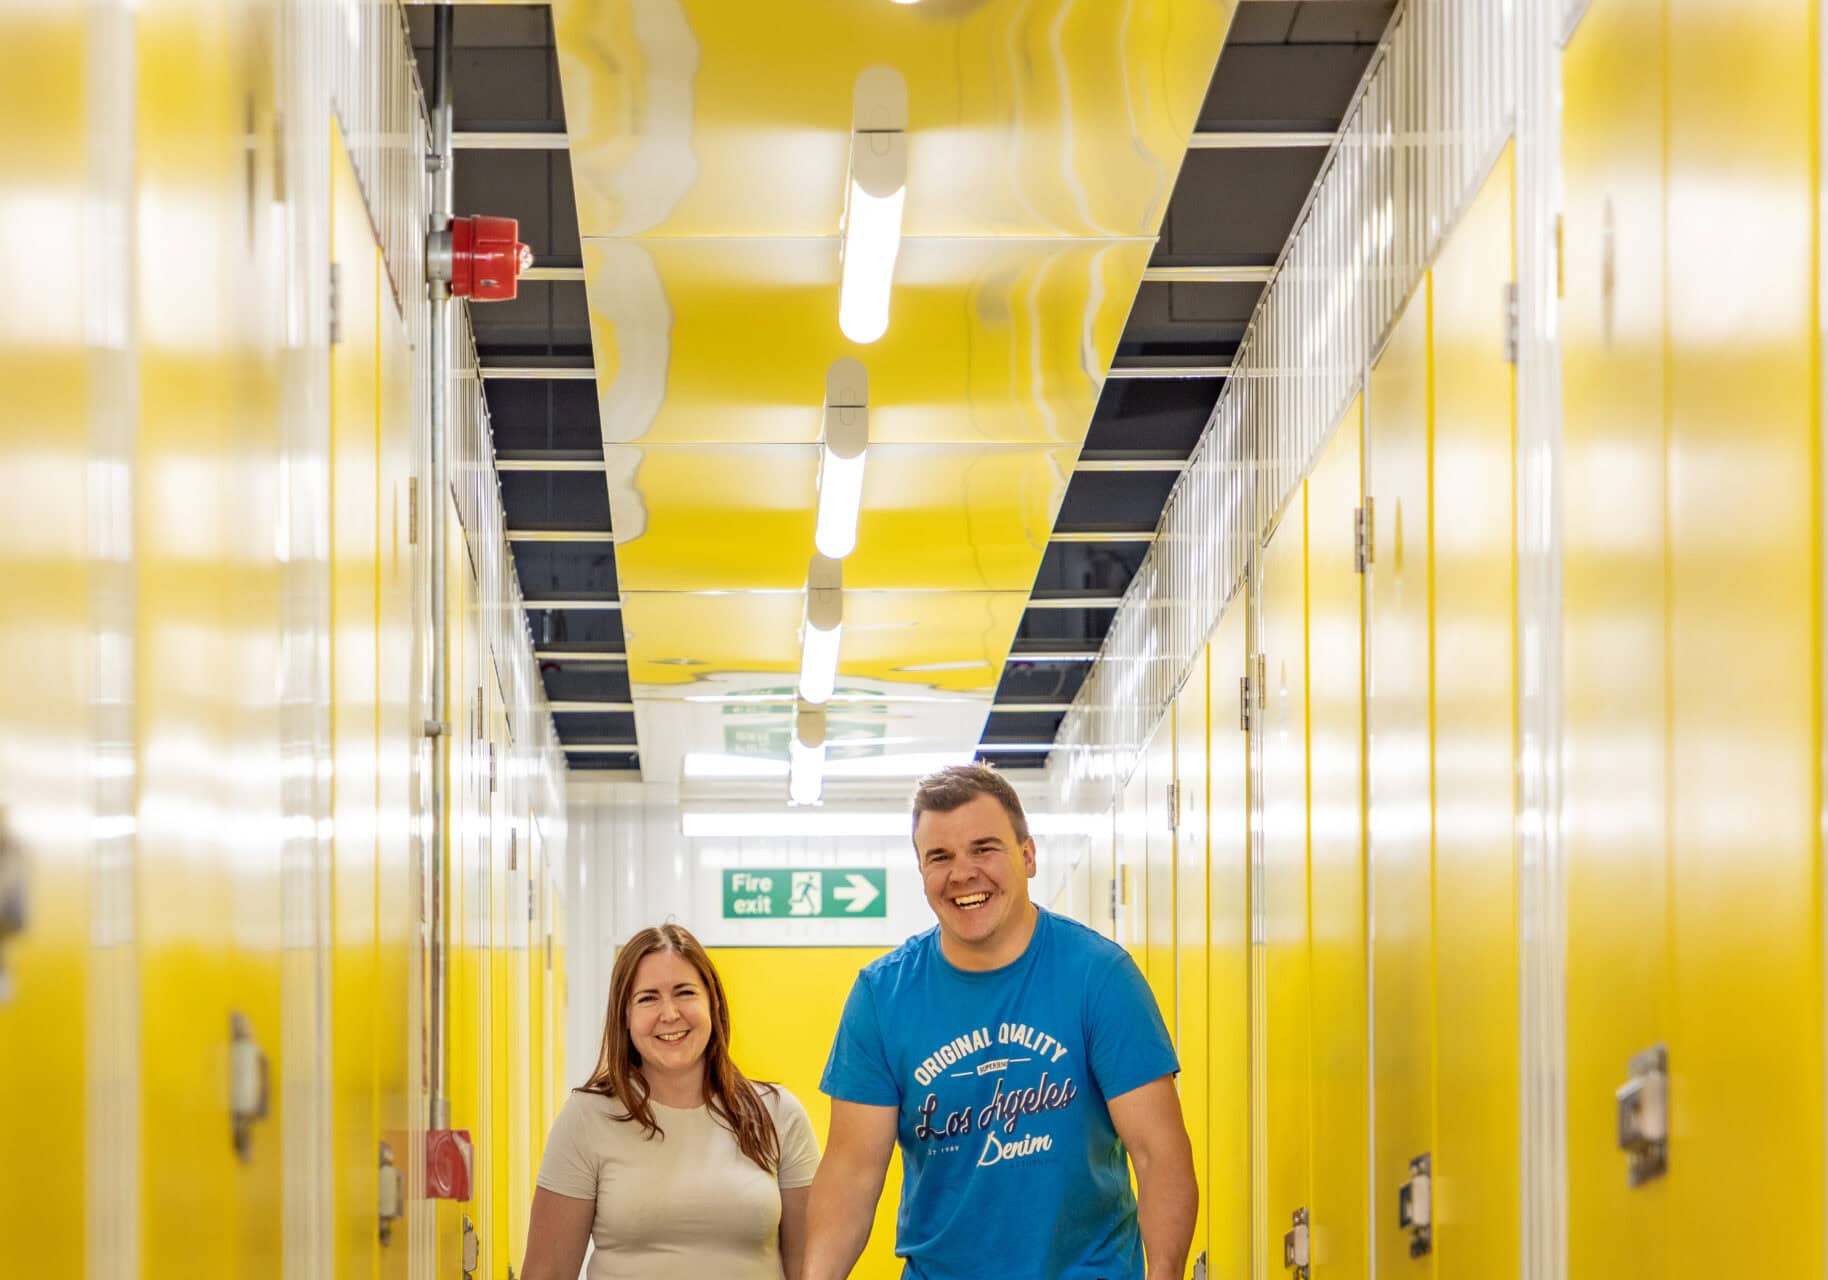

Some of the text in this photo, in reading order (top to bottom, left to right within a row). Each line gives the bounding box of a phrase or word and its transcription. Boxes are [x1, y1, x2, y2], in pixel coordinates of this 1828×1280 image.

[731, 873, 772, 893] Fire
[733, 895, 772, 914] exit
[914, 1027, 992, 1086] ORIGINAL
[915, 1071, 1078, 1139] Los Ageles
[976, 1130, 1053, 1167] Denim
